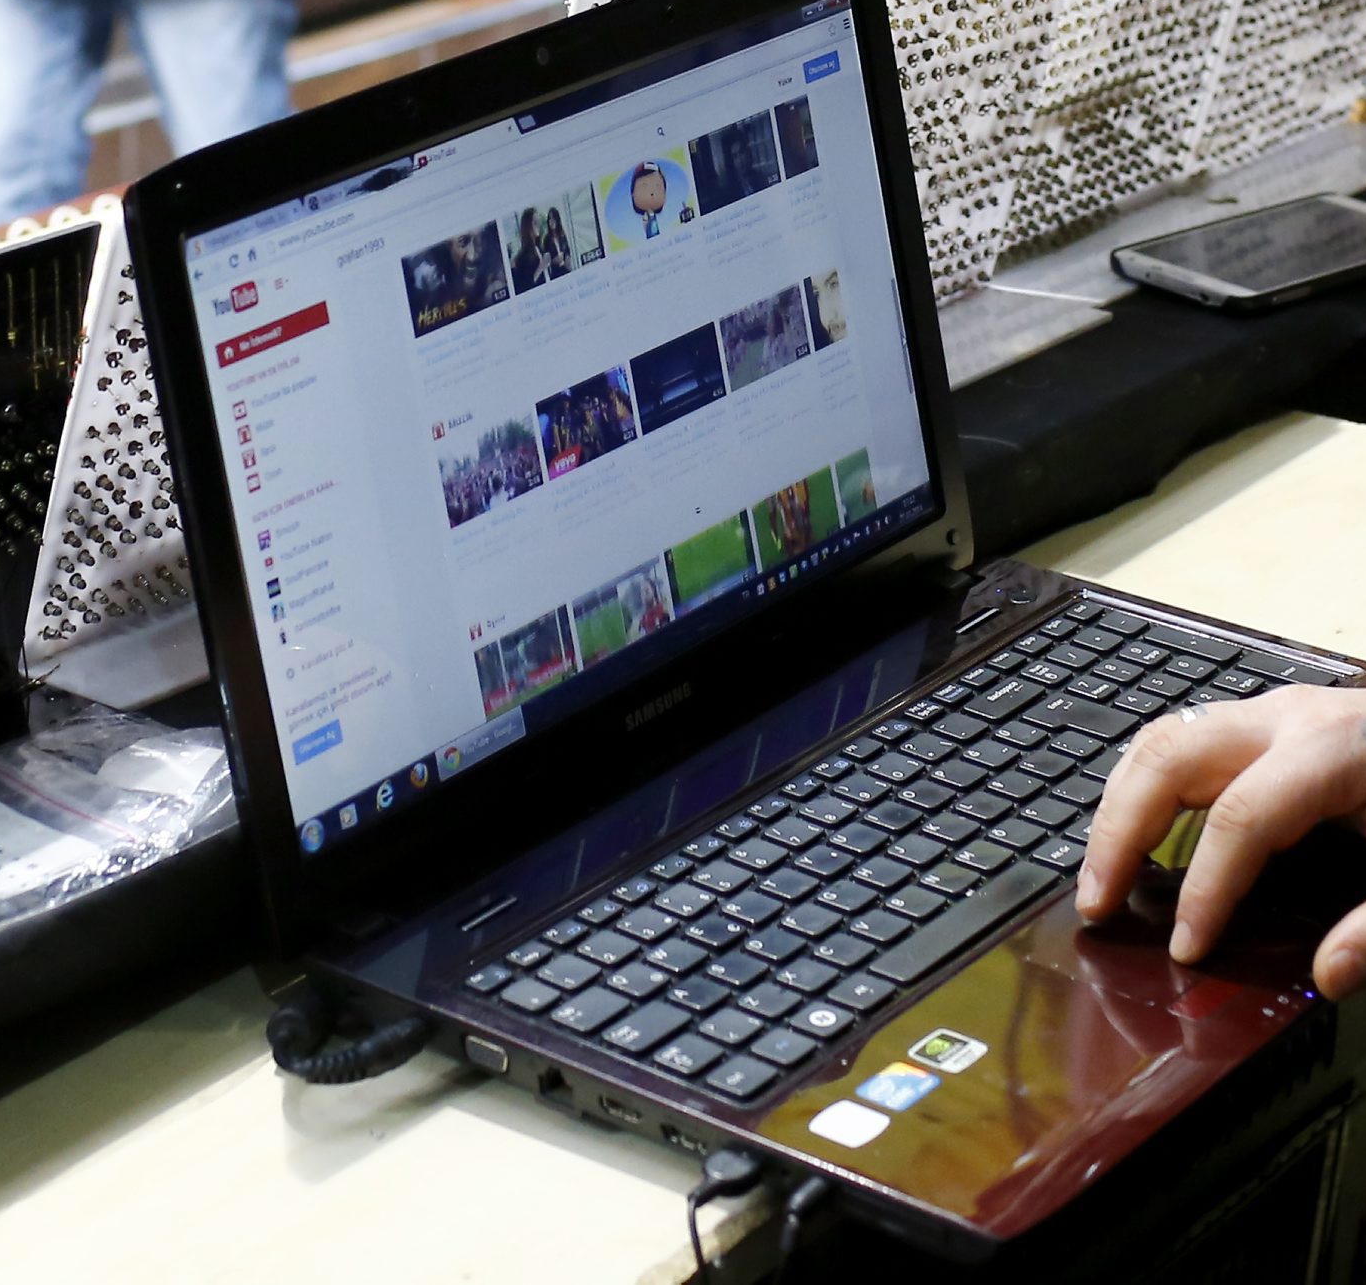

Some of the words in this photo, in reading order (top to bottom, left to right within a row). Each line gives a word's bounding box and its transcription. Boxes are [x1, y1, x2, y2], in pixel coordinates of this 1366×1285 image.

[279, 212, 354, 247] www.youtube.com
[212, 281, 259, 316] YouTube
[625, 681, 692, 732] SAMSUNG
[935, 770, 945, 778] P
[926, 823, 940, 831] K
[833, 835, 846, 843] U
[894, 846, 905, 854] J
[959, 852, 974, 860] M
[858, 868, 872, 877] H
[926, 875, 940, 883] N
[763, 880, 776, 888] T
[823, 892, 837, 900] G
[892, 899, 905, 907] B
[786, 917, 797, 925] F
[855, 921, 869, 930] V
[689, 927, 704, 936] E
[750, 940, 763, 949] D
[651, 949, 667, 959] W
[819, 946, 833, 955] C
[674, 989, 688, 999] A
